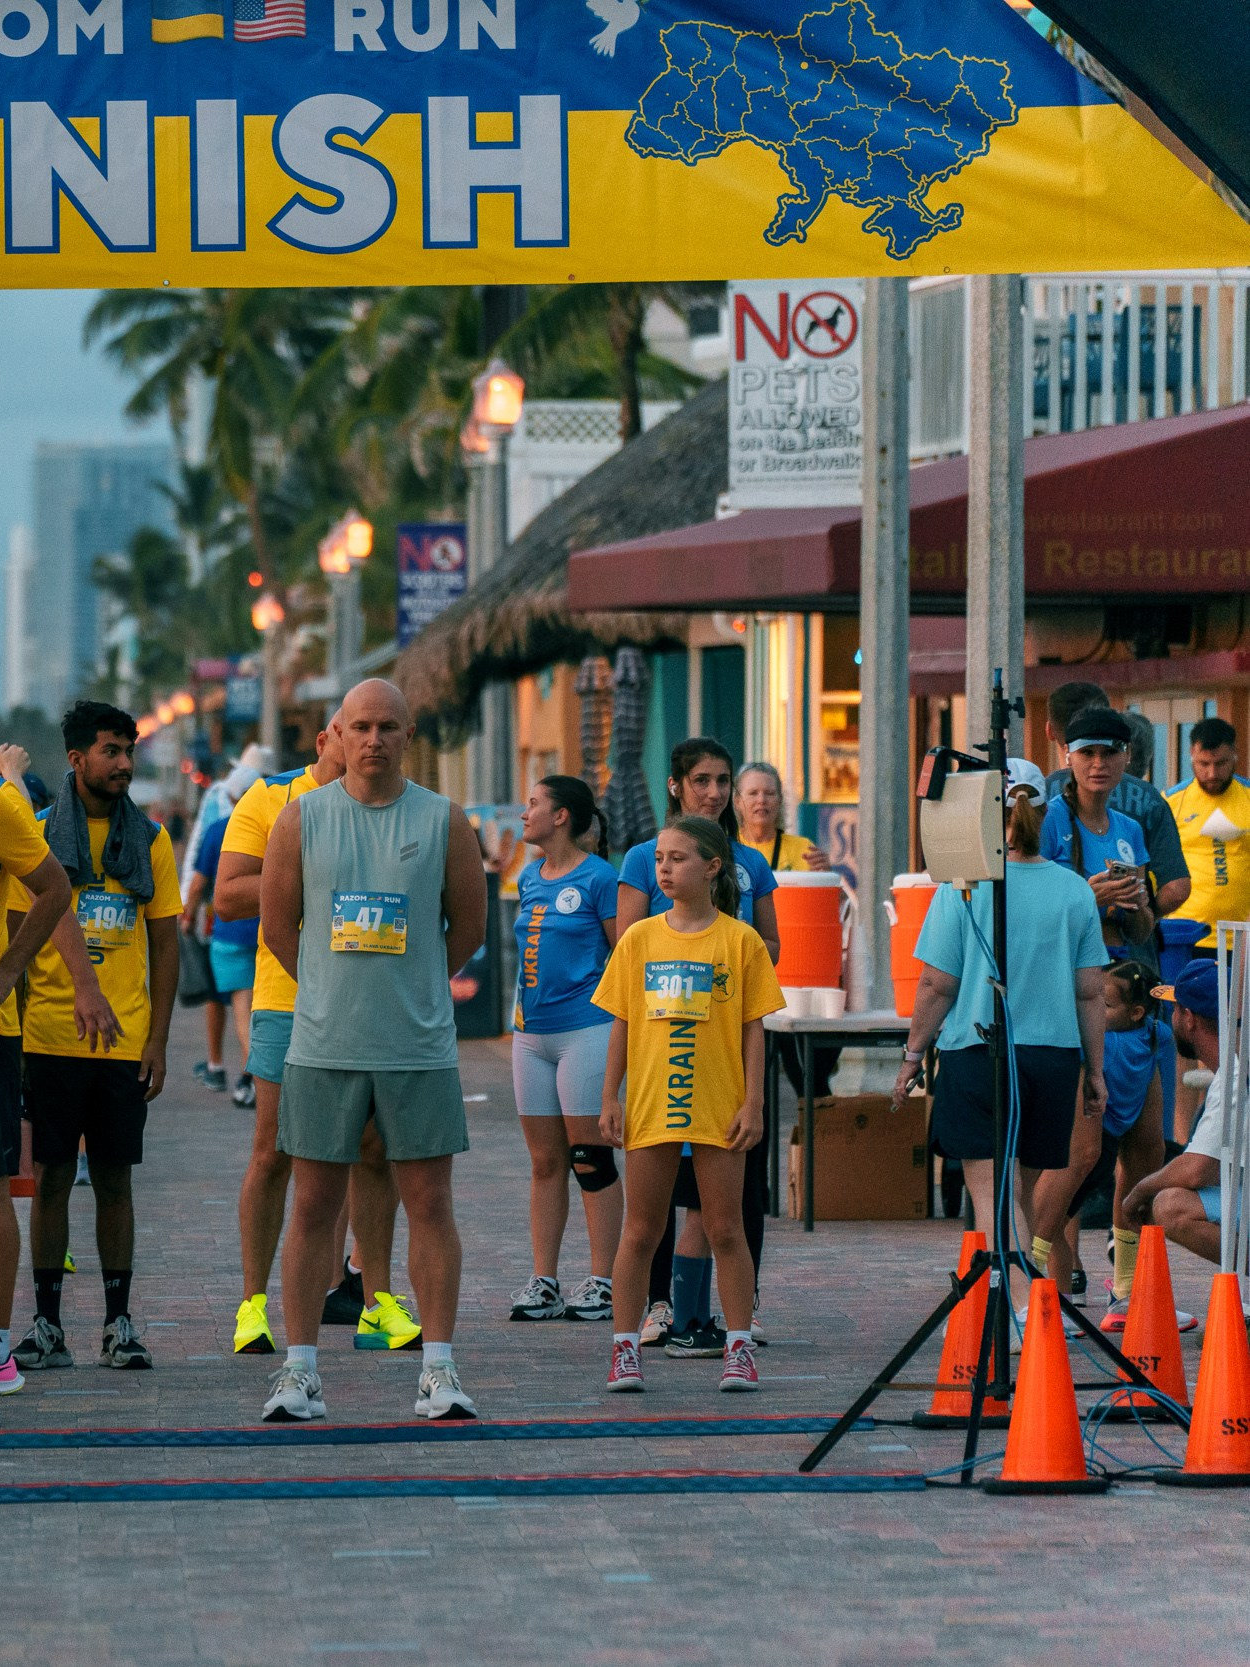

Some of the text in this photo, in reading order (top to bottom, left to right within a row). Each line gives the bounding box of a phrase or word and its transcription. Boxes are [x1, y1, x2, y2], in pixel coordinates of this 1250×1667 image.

[332, 0, 518, 54] RUN
[735, 363, 860, 406] PETS
[736, 405, 861, 431] ALLOWED
[737, 437, 763, 452] on
[770, 431, 797, 451] the
[737, 452, 861, 473] or Broadwalk
[1043, 538, 1250, 578] Restaura
[1212, 837, 1229, 886] UKRAI
[85, 894, 111, 902] RAZOM
[384, 896, 401, 904] RUN
[92, 905, 128, 931] 194
[354, 906, 384, 932] 47
[523, 904, 549, 988] UKRAINE
[651, 964, 706, 972] RAZOM RUN
[656, 974, 694, 1000] 301
[665, 1021, 697, 1129] UKRAIN
[952, 1364, 979, 1381] SS
[1221, 1417, 1250, 1436] SS
